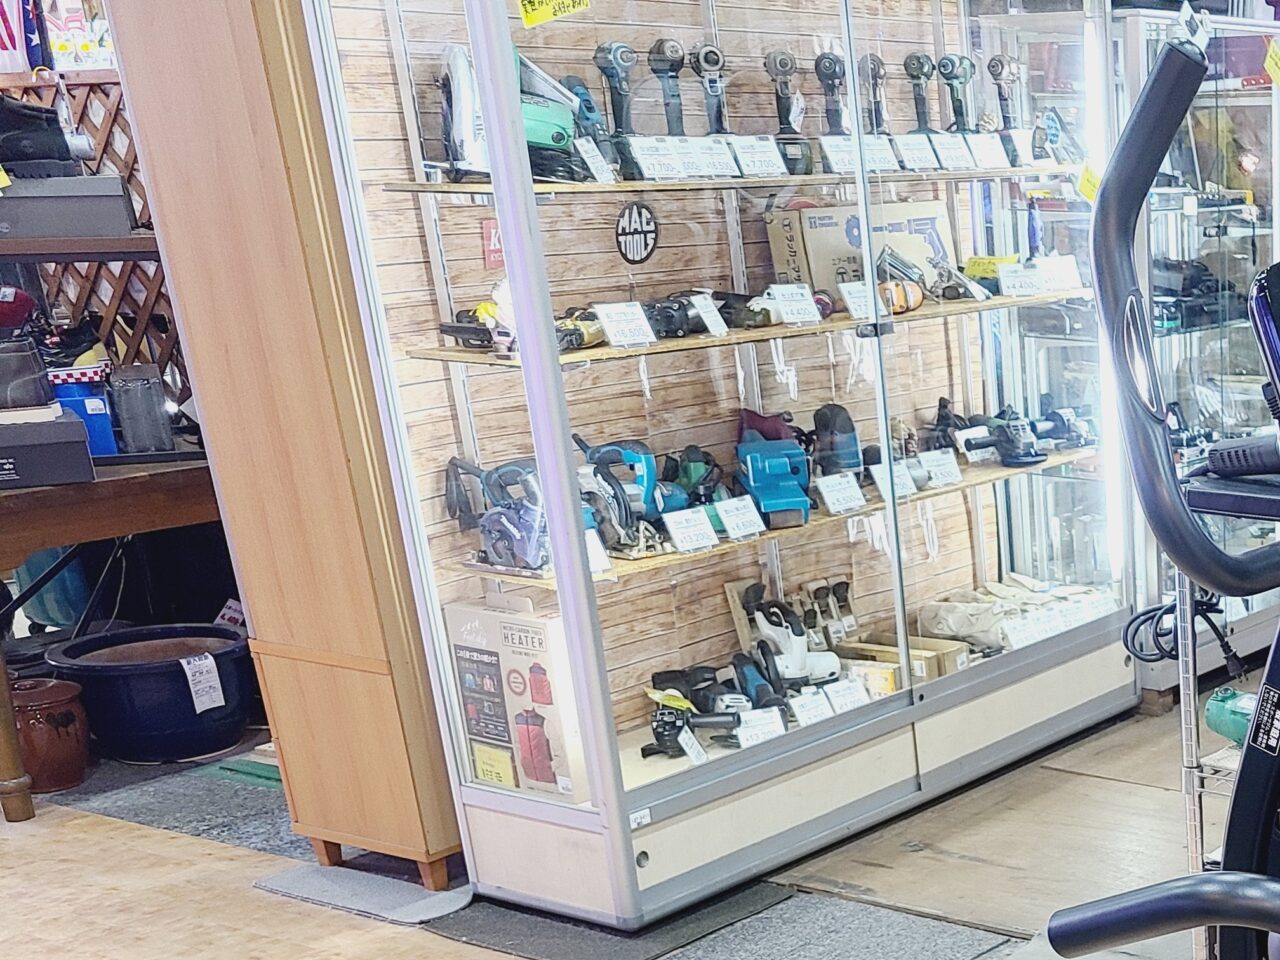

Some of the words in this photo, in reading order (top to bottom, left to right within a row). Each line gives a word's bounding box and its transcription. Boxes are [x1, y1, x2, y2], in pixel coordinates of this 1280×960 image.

[618, 204, 655, 233] MAC
[618, 233, 655, 261] TOOLS
[503, 631, 545, 649] HEATER
